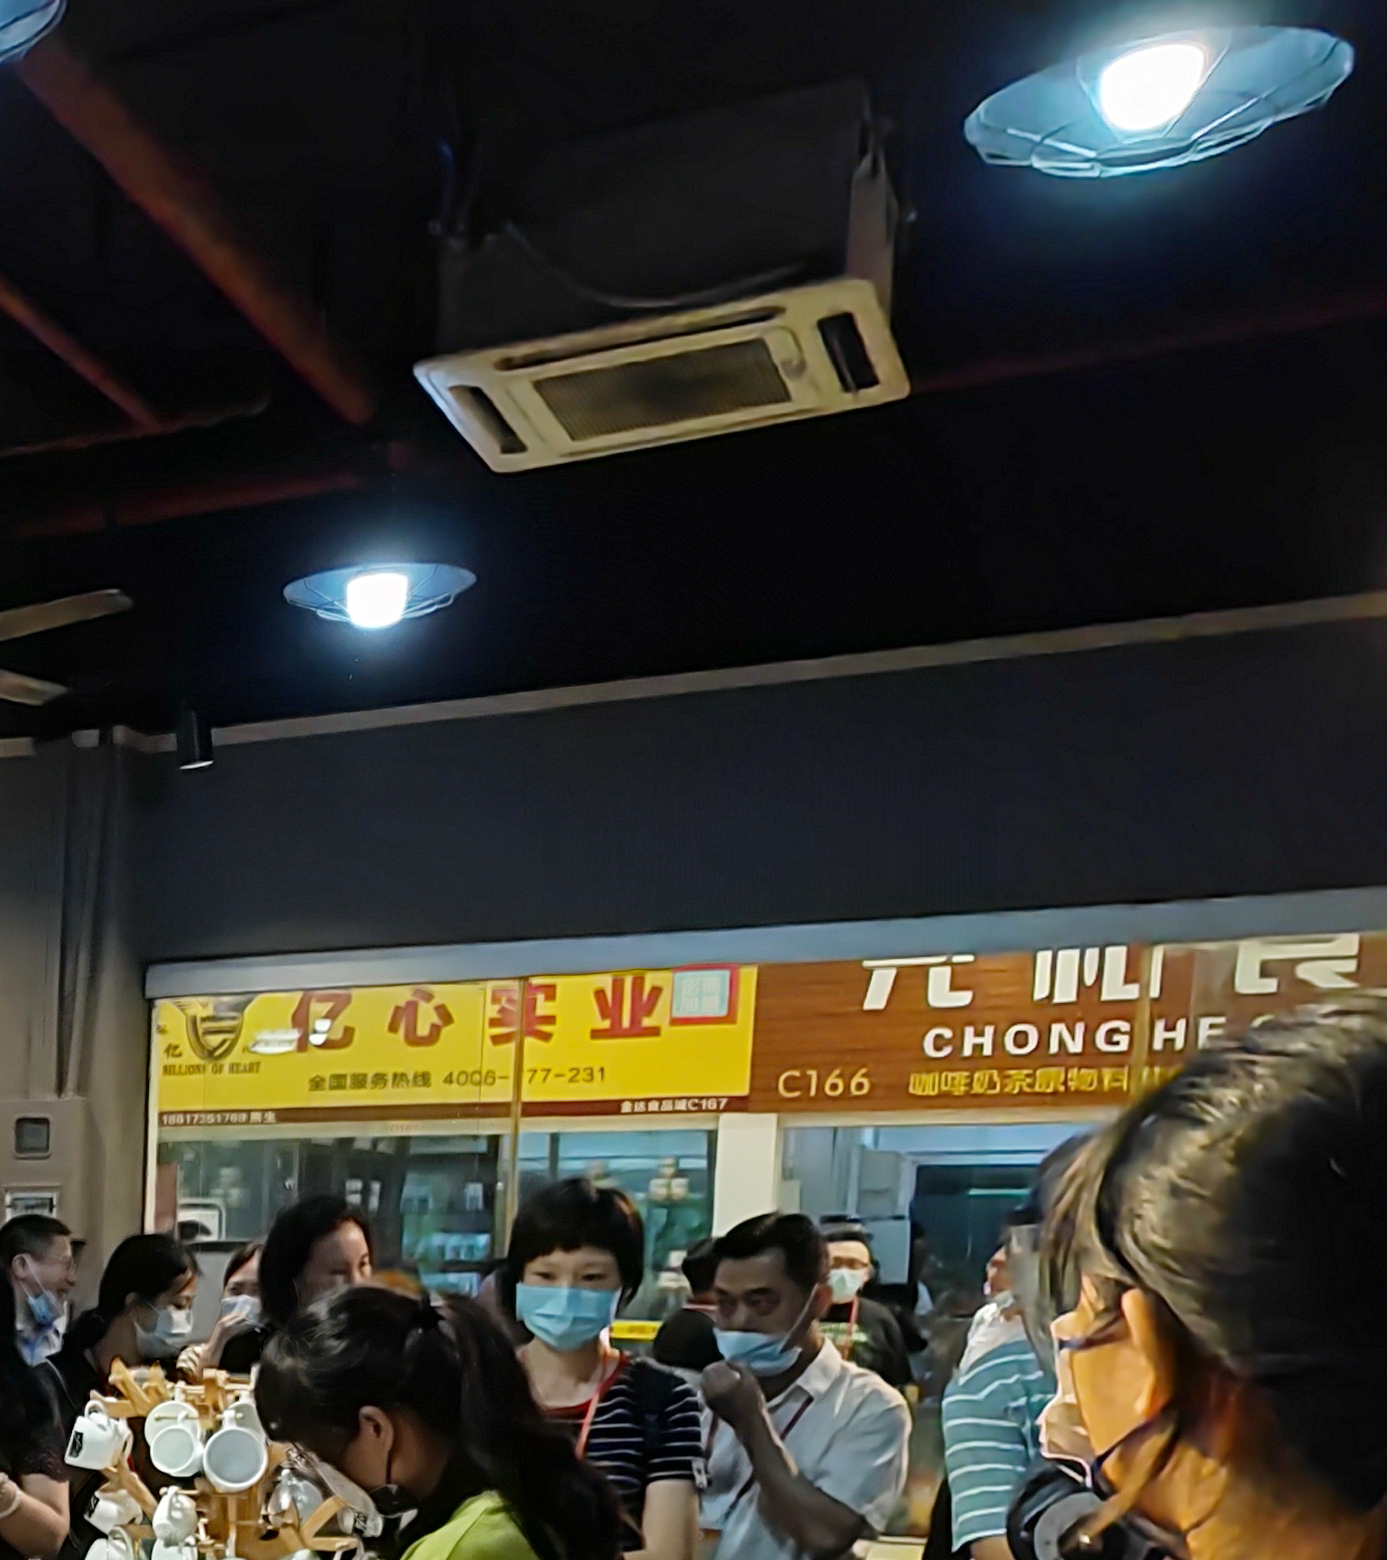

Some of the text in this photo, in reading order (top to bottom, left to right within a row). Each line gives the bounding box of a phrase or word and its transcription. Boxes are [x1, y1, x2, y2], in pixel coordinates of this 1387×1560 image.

[291, 973, 663, 1053] 亿心实业
[923, 1020, 1131, 1058] CHONG
[211, 1063, 224, 1075] OF
[228, 1061, 262, 1075] HEART
[308, 1066, 605, 1092] 全国服务热线 4006-77-231
[778, 1068, 871, 1099] C166
